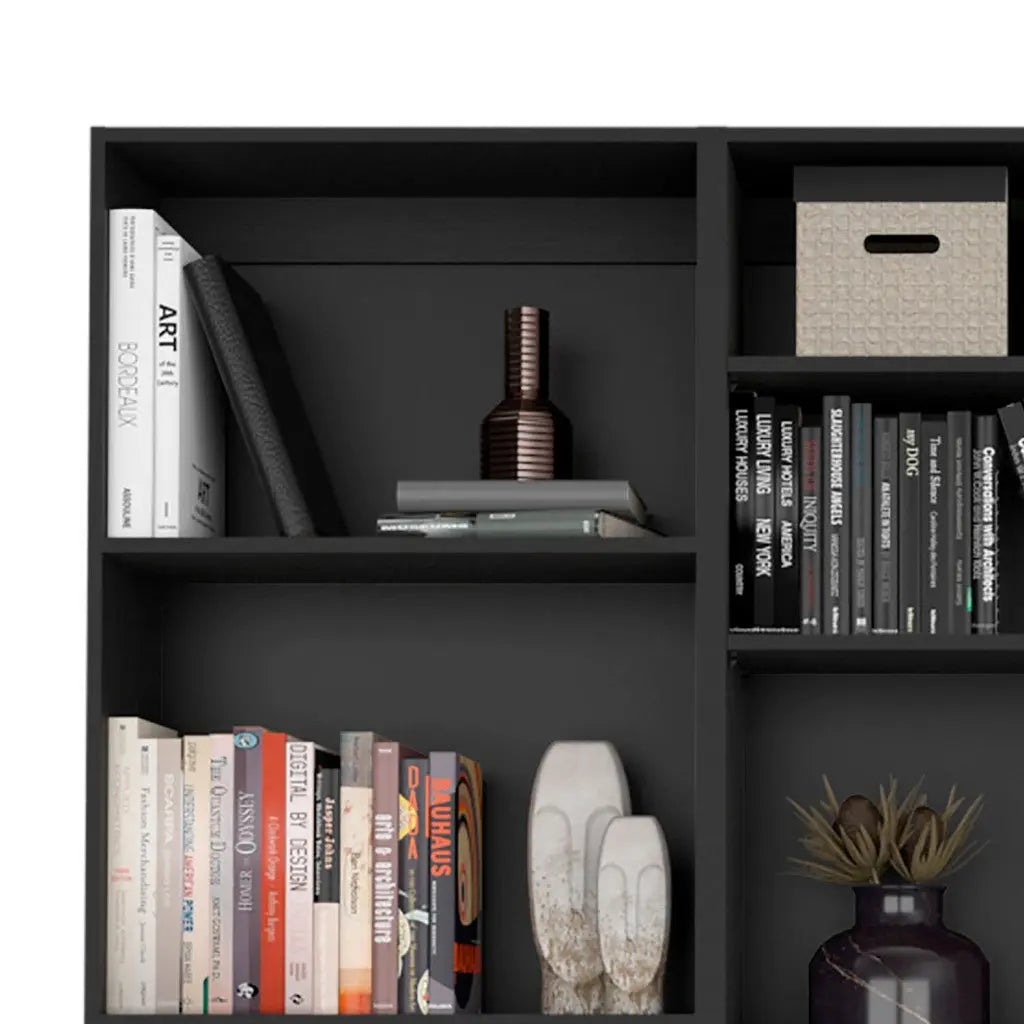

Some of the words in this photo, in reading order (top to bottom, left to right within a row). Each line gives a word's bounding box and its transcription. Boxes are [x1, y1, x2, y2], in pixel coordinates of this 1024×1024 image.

[158, 304, 178, 352] ART
[117, 341, 139, 428] BORDEAUX
[734, 409, 748, 453] LUXURY
[755, 413, 771, 457] LUXURY
[780, 420, 792, 462] LUXURY
[830, 408, 843, 489] SLAUGHTERHOUSE
[929, 436, 942, 457] Time
[734, 456, 748, 502] HOUSES
[755, 460, 771, 494] LIVING
[906, 447, 919, 477] DOG
[929, 459, 942, 473] and
[780, 465, 792, 507] HOTELS
[929, 475, 942, 504] Silence
[982, 446, 995, 522] Conversations
[799, 496, 817, 552] INIQUITY
[830, 491, 843, 526] ANGELS
[755, 519, 771, 543] NEW
[780, 520, 792, 568] AMERICA
[982, 525, 995, 547] with
[755, 545, 771, 578] YORK
[982, 549, 995, 602] Architects
[290, 744, 307, 802] DIGITAL
[140, 787, 150, 829] Fashion
[163, 773, 174, 844] SCARPA
[235, 791, 257, 854] ODYSSEY
[290, 812, 307, 831] BY
[322, 797, 335, 833] Jasper
[407, 765, 420, 860] DADA
[430, 778, 451, 878] BAUHAUS
[137, 832, 150, 914] Merchandising
[290, 838, 307, 891] DESIGN
[323, 836, 335, 869] Johns
[183, 855, 195, 897] AMERICAN
[238, 871, 250, 911] HOMER
[349, 873, 360, 914] Nicholson
[183, 899, 193, 932] POWER
